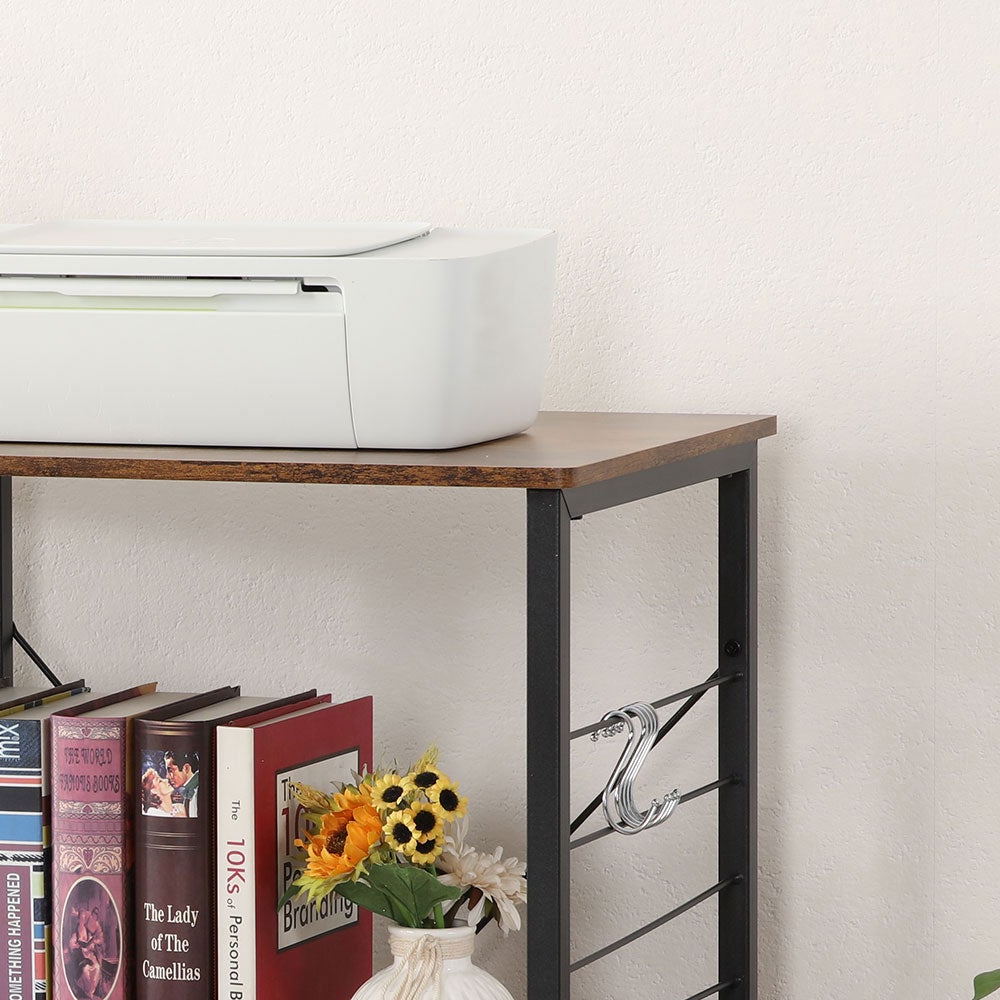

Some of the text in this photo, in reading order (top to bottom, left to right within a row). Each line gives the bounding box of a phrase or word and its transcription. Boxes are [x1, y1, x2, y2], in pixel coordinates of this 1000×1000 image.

[231, 800, 241, 821] The
[226, 839, 246, 895] 10Ks
[6, 872, 21, 936] HAPPENED
[143, 902, 199, 927] The Lady
[227, 898, 235, 910] of
[151, 933, 190, 953] of The
[229, 915, 243, 986] Personal
[142, 959, 201, 981] Camellias
